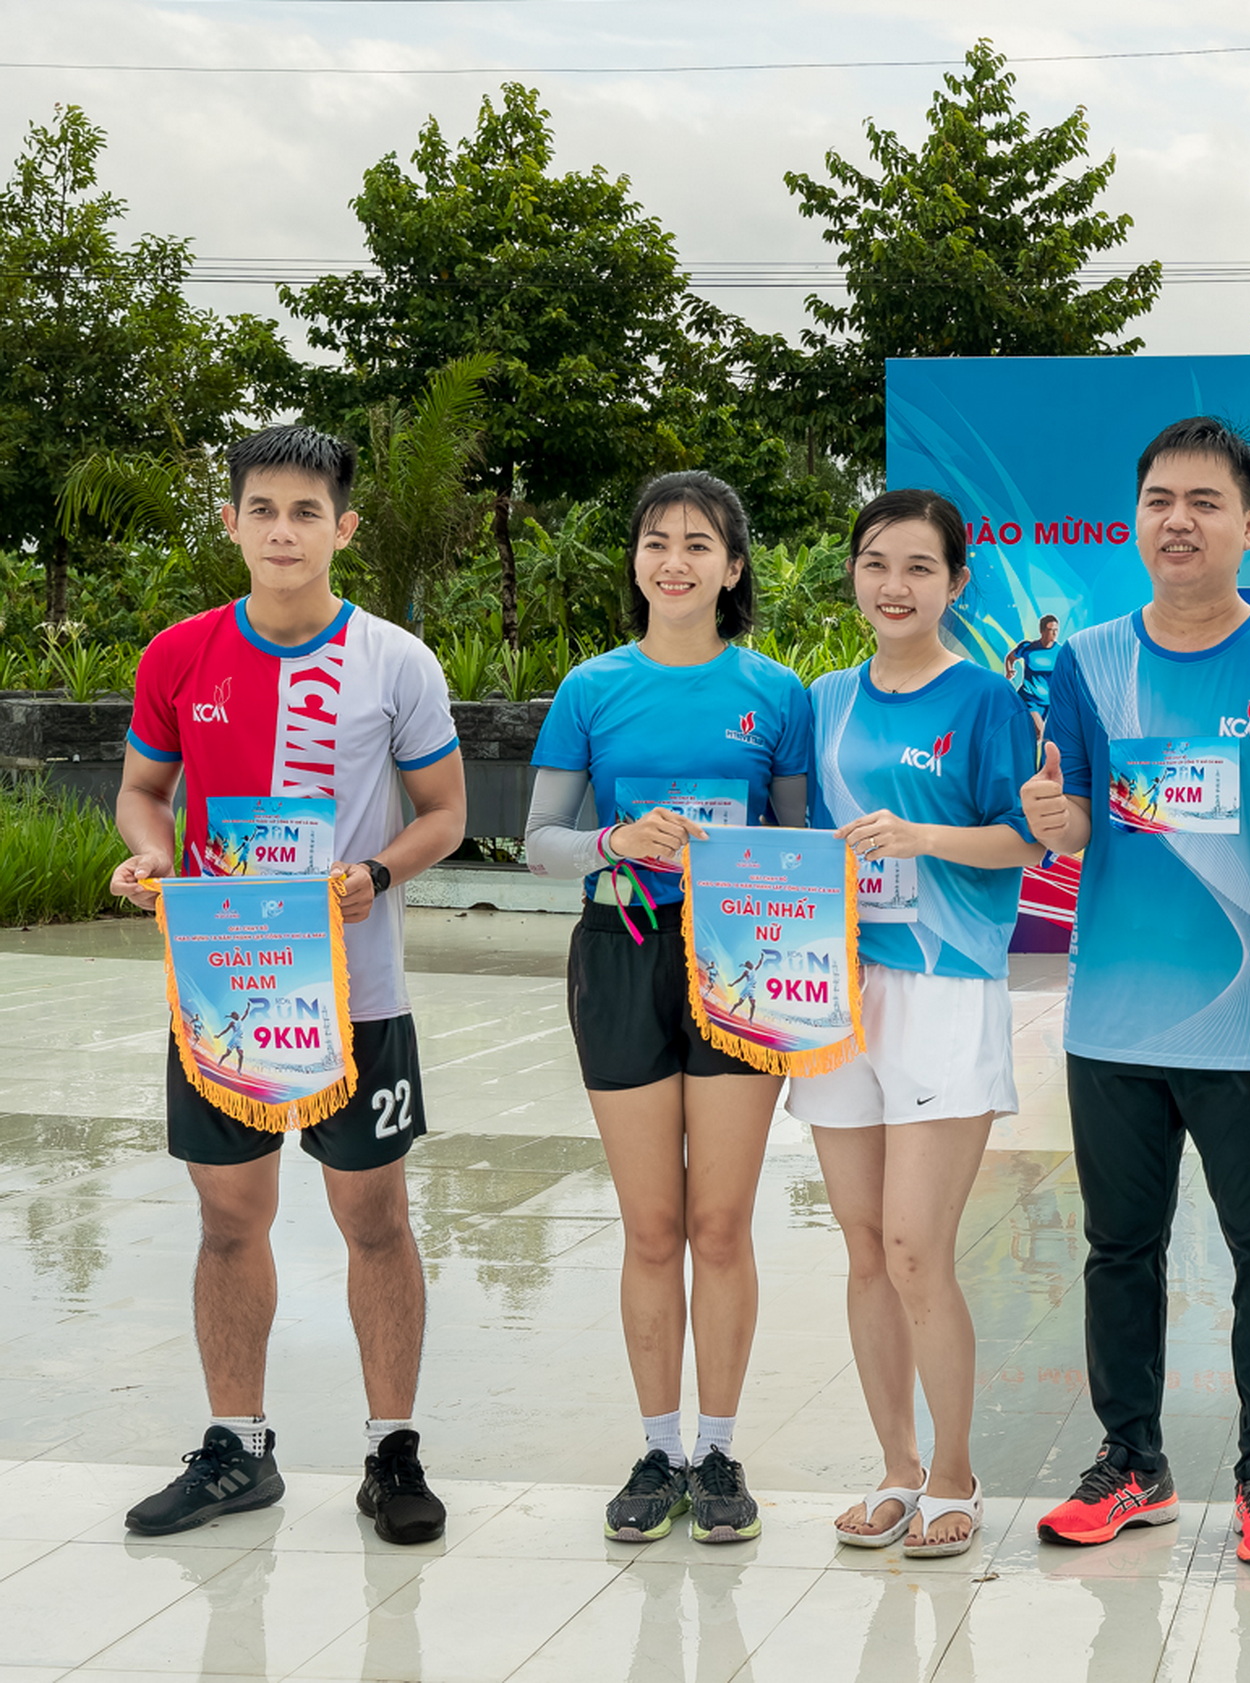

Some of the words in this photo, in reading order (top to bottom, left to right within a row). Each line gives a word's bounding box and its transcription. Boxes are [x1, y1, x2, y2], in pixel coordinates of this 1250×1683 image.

[1034, 515, 1130, 545] MỪNG
[192, 702, 229, 724] KCM
[900, 746, 941, 777] KCM
[1164, 786, 1202, 803] 9KM
[255, 846, 296, 863] 9KM
[721, 895, 761, 916] GIẢI
[767, 898, 816, 919] NHẤT
[755, 922, 782, 942] NỮ
[208, 946, 252, 967] GIẢI
[761, 948, 830, 974] RUN
[230, 974, 276, 990] NAM
[766, 977, 828, 1004] 9KM
[248, 997, 321, 1020] RUN
[253, 1026, 320, 1049] 9KM
[371, 1079, 412, 1140] 22
